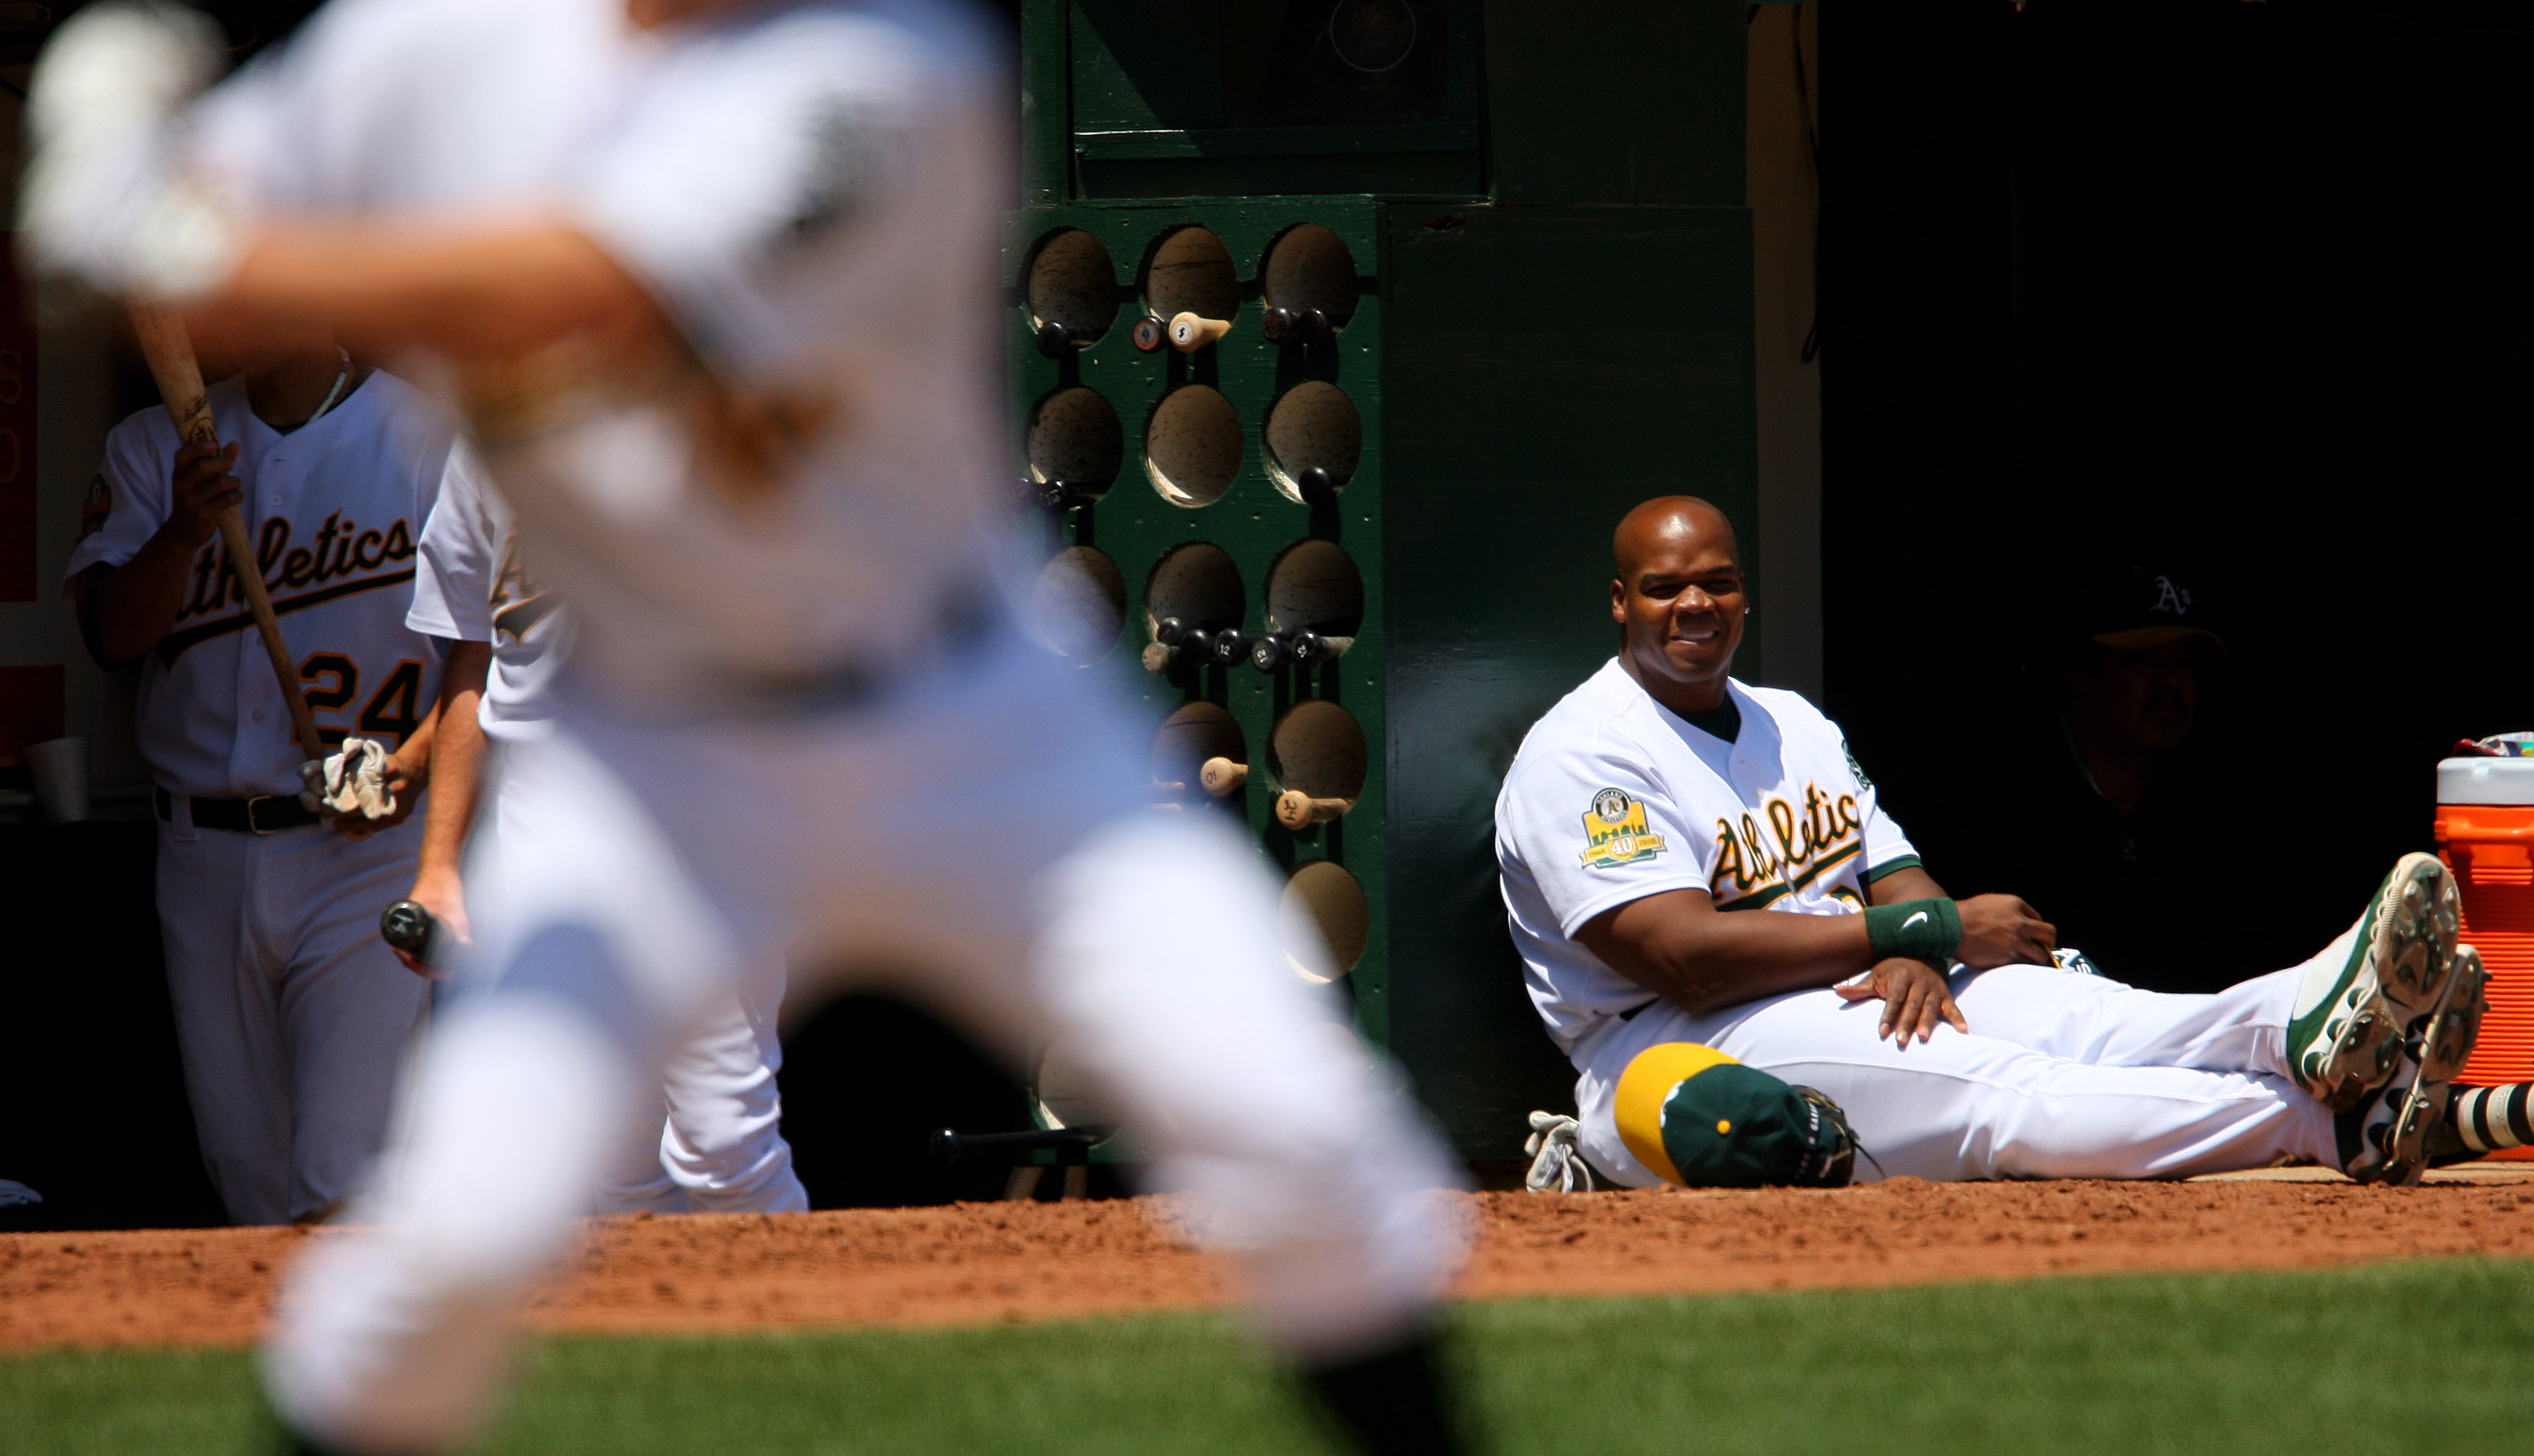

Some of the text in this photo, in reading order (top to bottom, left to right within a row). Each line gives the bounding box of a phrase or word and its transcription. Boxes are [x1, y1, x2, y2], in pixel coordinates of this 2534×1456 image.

[175, 507, 416, 622] thletics
[1219, 644, 1231, 656] 12
[291, 652, 424, 751] 24
[1611, 836, 1634, 855] 40
